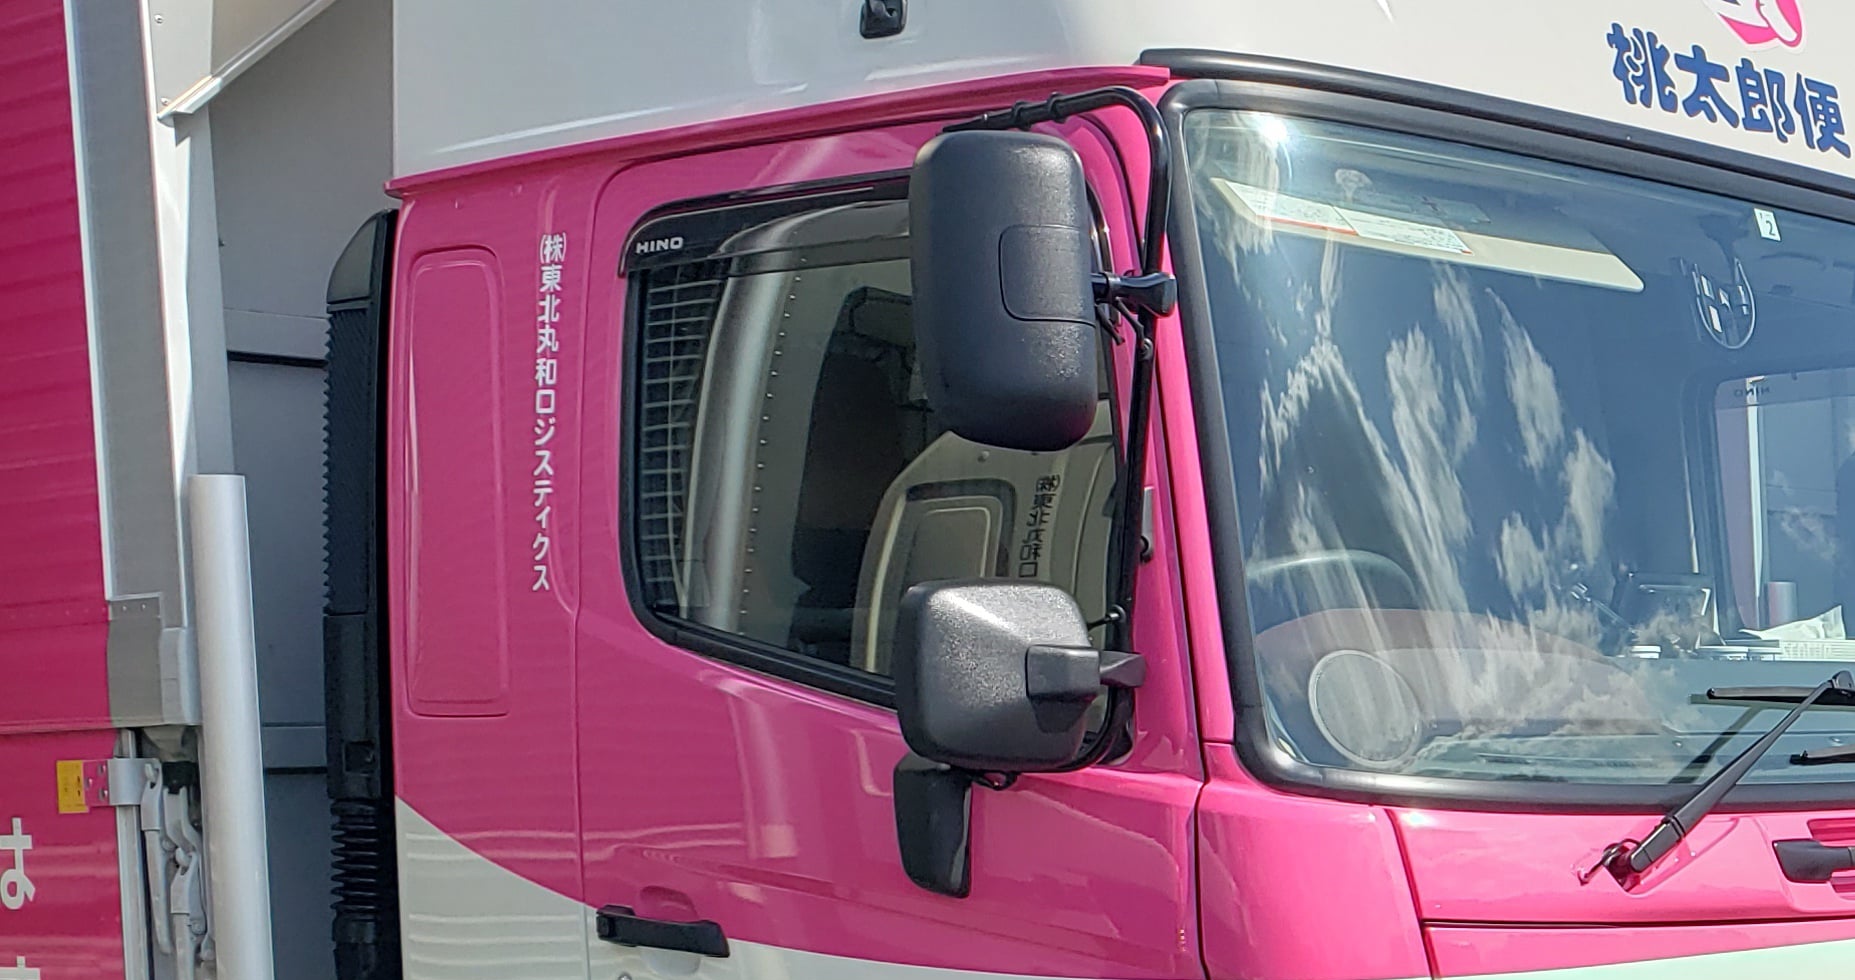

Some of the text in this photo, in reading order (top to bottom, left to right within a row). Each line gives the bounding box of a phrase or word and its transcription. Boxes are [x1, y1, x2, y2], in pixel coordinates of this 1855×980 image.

[1606, 22, 1851, 158] 桃太郎便
[636, 236, 684, 254] HINO
